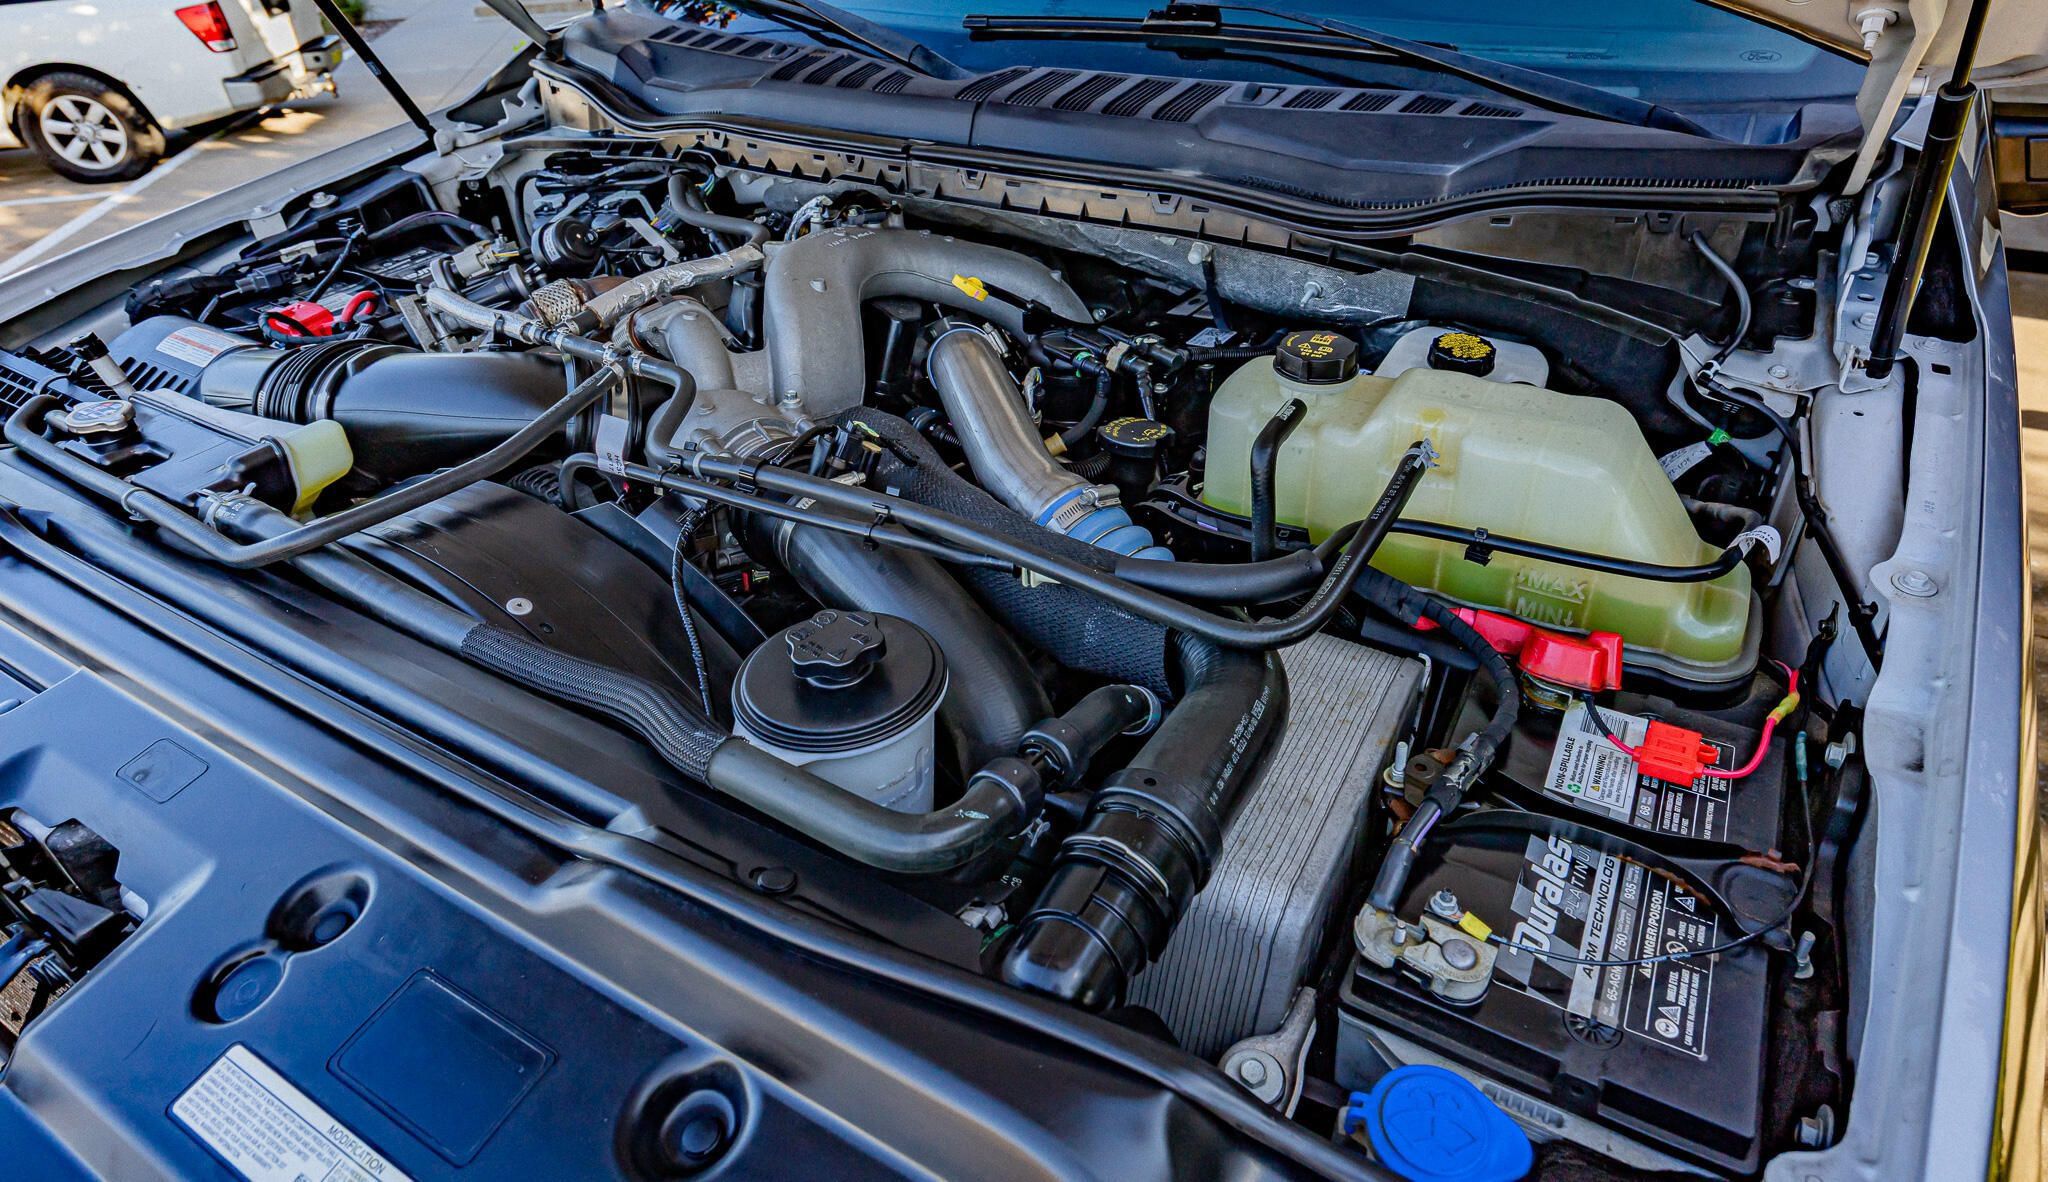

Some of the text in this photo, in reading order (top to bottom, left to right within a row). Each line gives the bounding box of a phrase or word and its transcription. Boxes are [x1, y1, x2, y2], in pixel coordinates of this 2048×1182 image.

[1527, 567, 1587, 600] MAX
[1516, 595, 1562, 625] MIN
[1554, 736, 1575, 789] NON-SPILLABLE
[1592, 752, 1606, 785] WARNING:
[1639, 804, 1650, 815] 68
[1509, 837, 1573, 962] Duralas
[1624, 882, 1637, 899] 935
[1614, 932, 1628, 951] 750
[1641, 889, 1664, 968] DANGER/POISON
[1583, 943, 1598, 978] AGM
[1606, 964, 1622, 1001] 65-AGM
[327, 1124, 387, 1176] MODIFICATION
